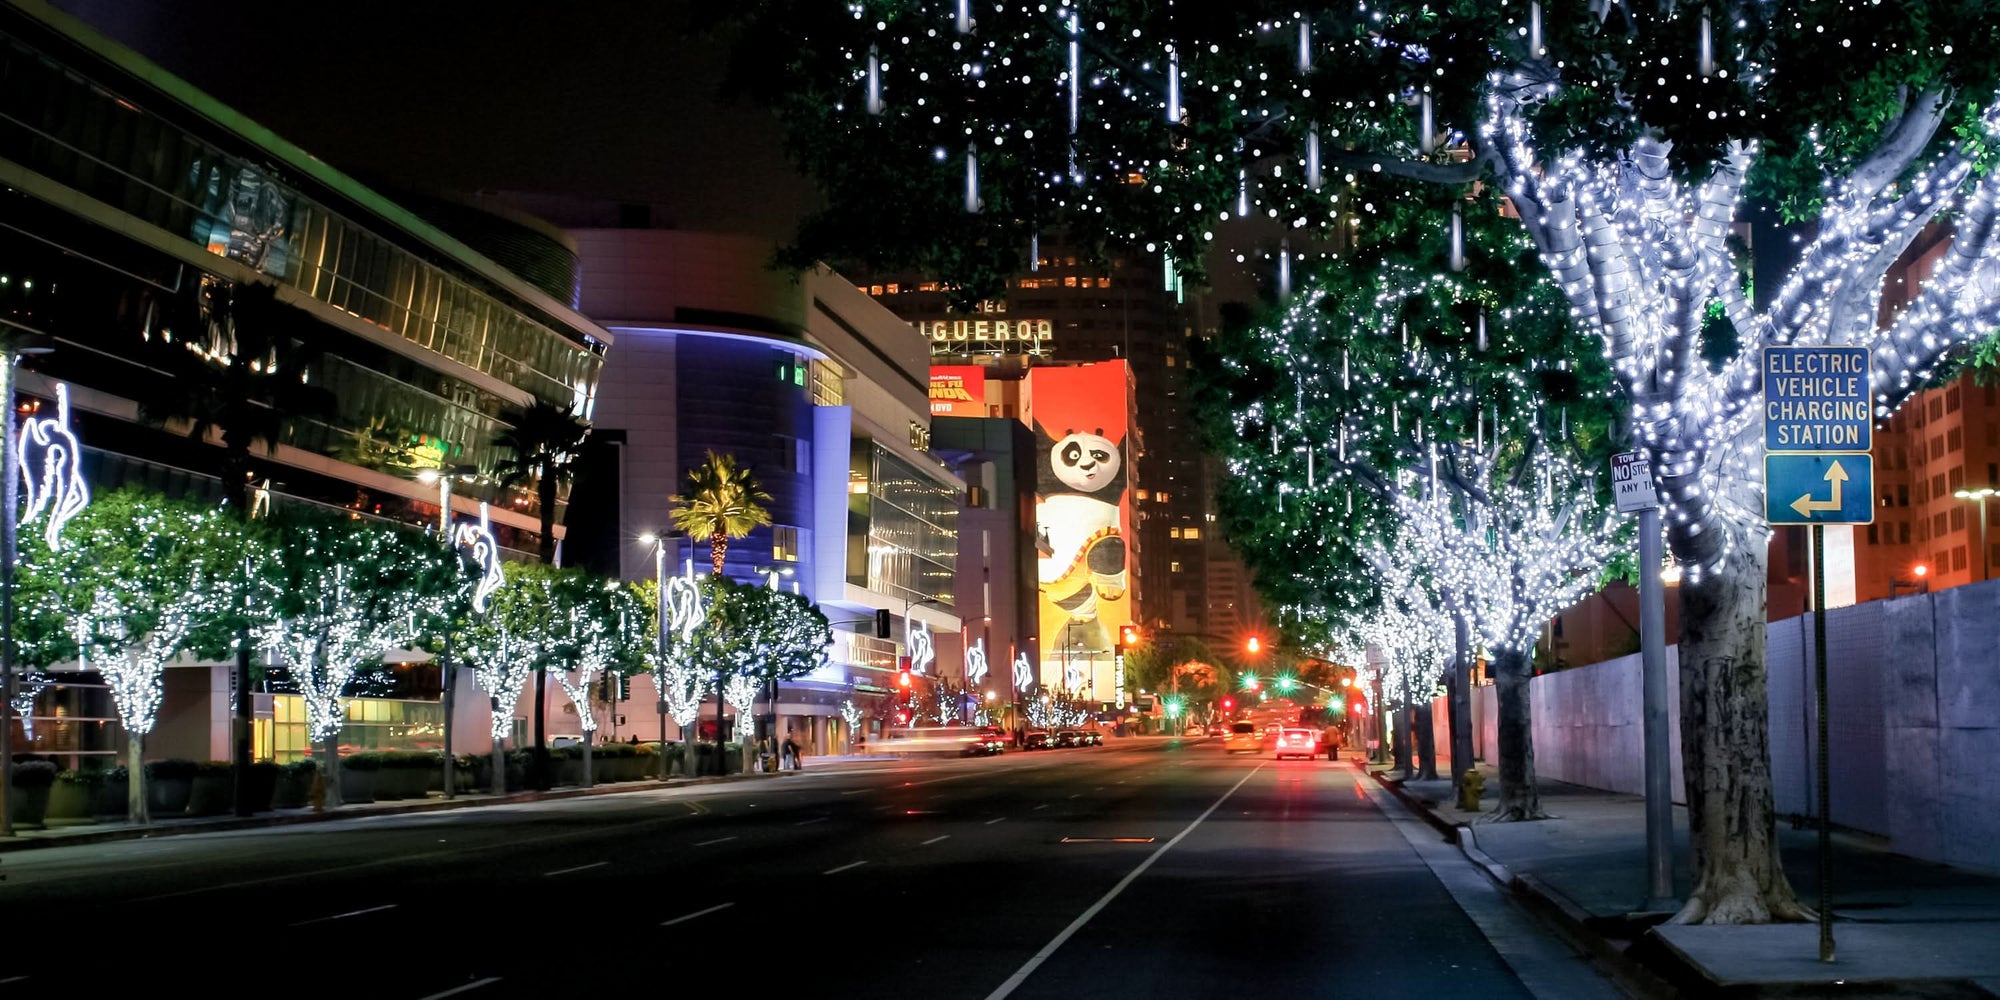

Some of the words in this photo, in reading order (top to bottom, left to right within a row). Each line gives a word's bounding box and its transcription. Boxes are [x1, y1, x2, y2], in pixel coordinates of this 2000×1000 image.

[906, 320, 1052, 341] IGUEROA
[1769, 353, 1863, 374] ELECTRIC
[929, 388, 974, 400] NDA
[1776, 377, 1859, 397] VEHICLE
[935, 403, 952, 412] DVD
[1767, 401, 1868, 421] CHARGING
[1778, 424, 1859, 445] STATION
[1618, 453, 1635, 463] TOW
[1613, 464, 1630, 481] NO
[1621, 482, 1638, 494] ANY
